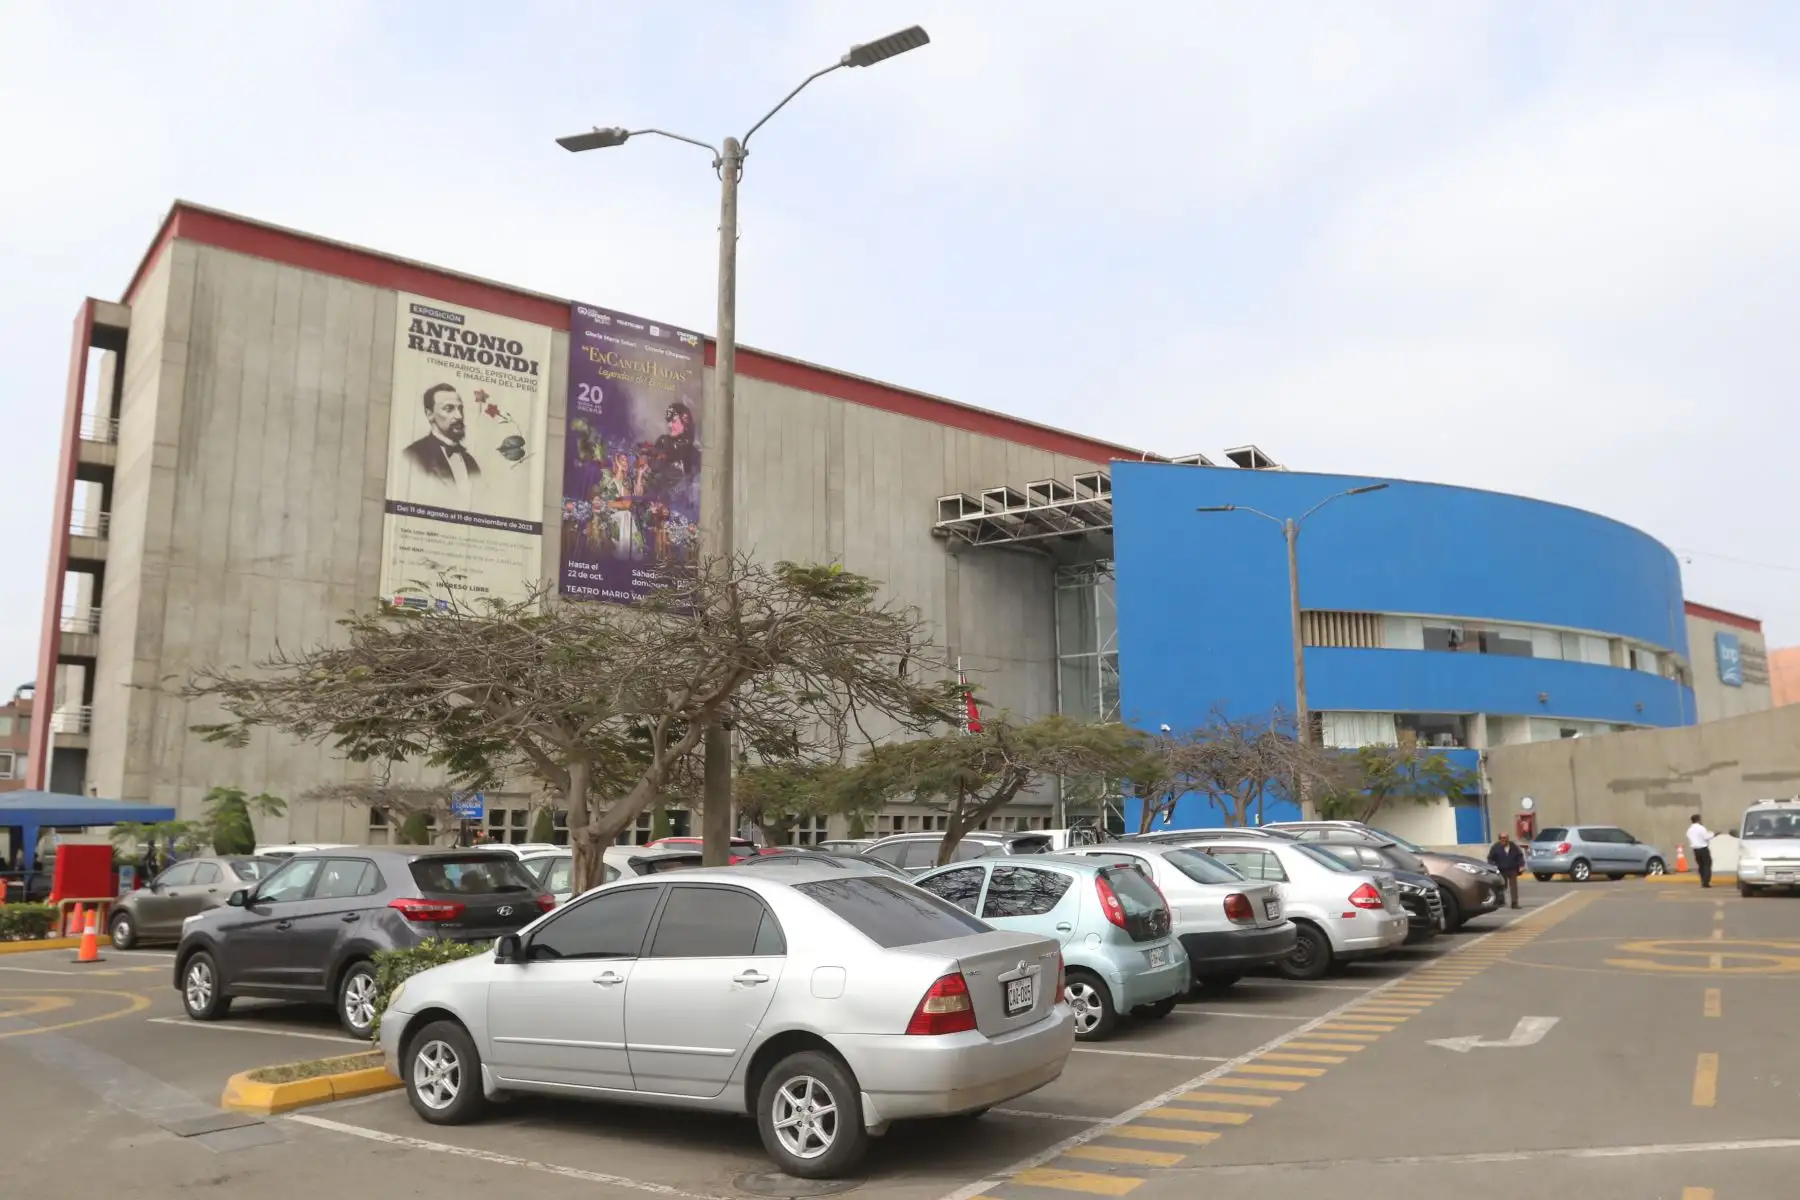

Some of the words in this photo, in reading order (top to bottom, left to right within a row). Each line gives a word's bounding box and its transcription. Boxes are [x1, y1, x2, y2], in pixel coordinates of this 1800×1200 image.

[408, 318, 524, 355] ANTONIO
[408, 333, 539, 375] RAIMONDI
[463, 372, 497, 385] IMAGEN
[498, 380, 514, 389] DEL
[485, 369, 538, 386] EPISTOLARIO
[578, 383, 603, 404] 20
[397, 505, 408, 513] Del
[427, 510, 449, 519] agosto
[464, 514, 472, 522] de
[473, 516, 507, 528] noviembre
[508, 521, 517, 529] de
[518, 523, 533, 531] 2023
[568, 560, 590, 569] Hasta
[578, 571, 588, 579] de
[469, 584, 490, 593] LIBRE
[566, 585, 599, 595] TEATRO
[602, 589, 630, 599] MARIO
